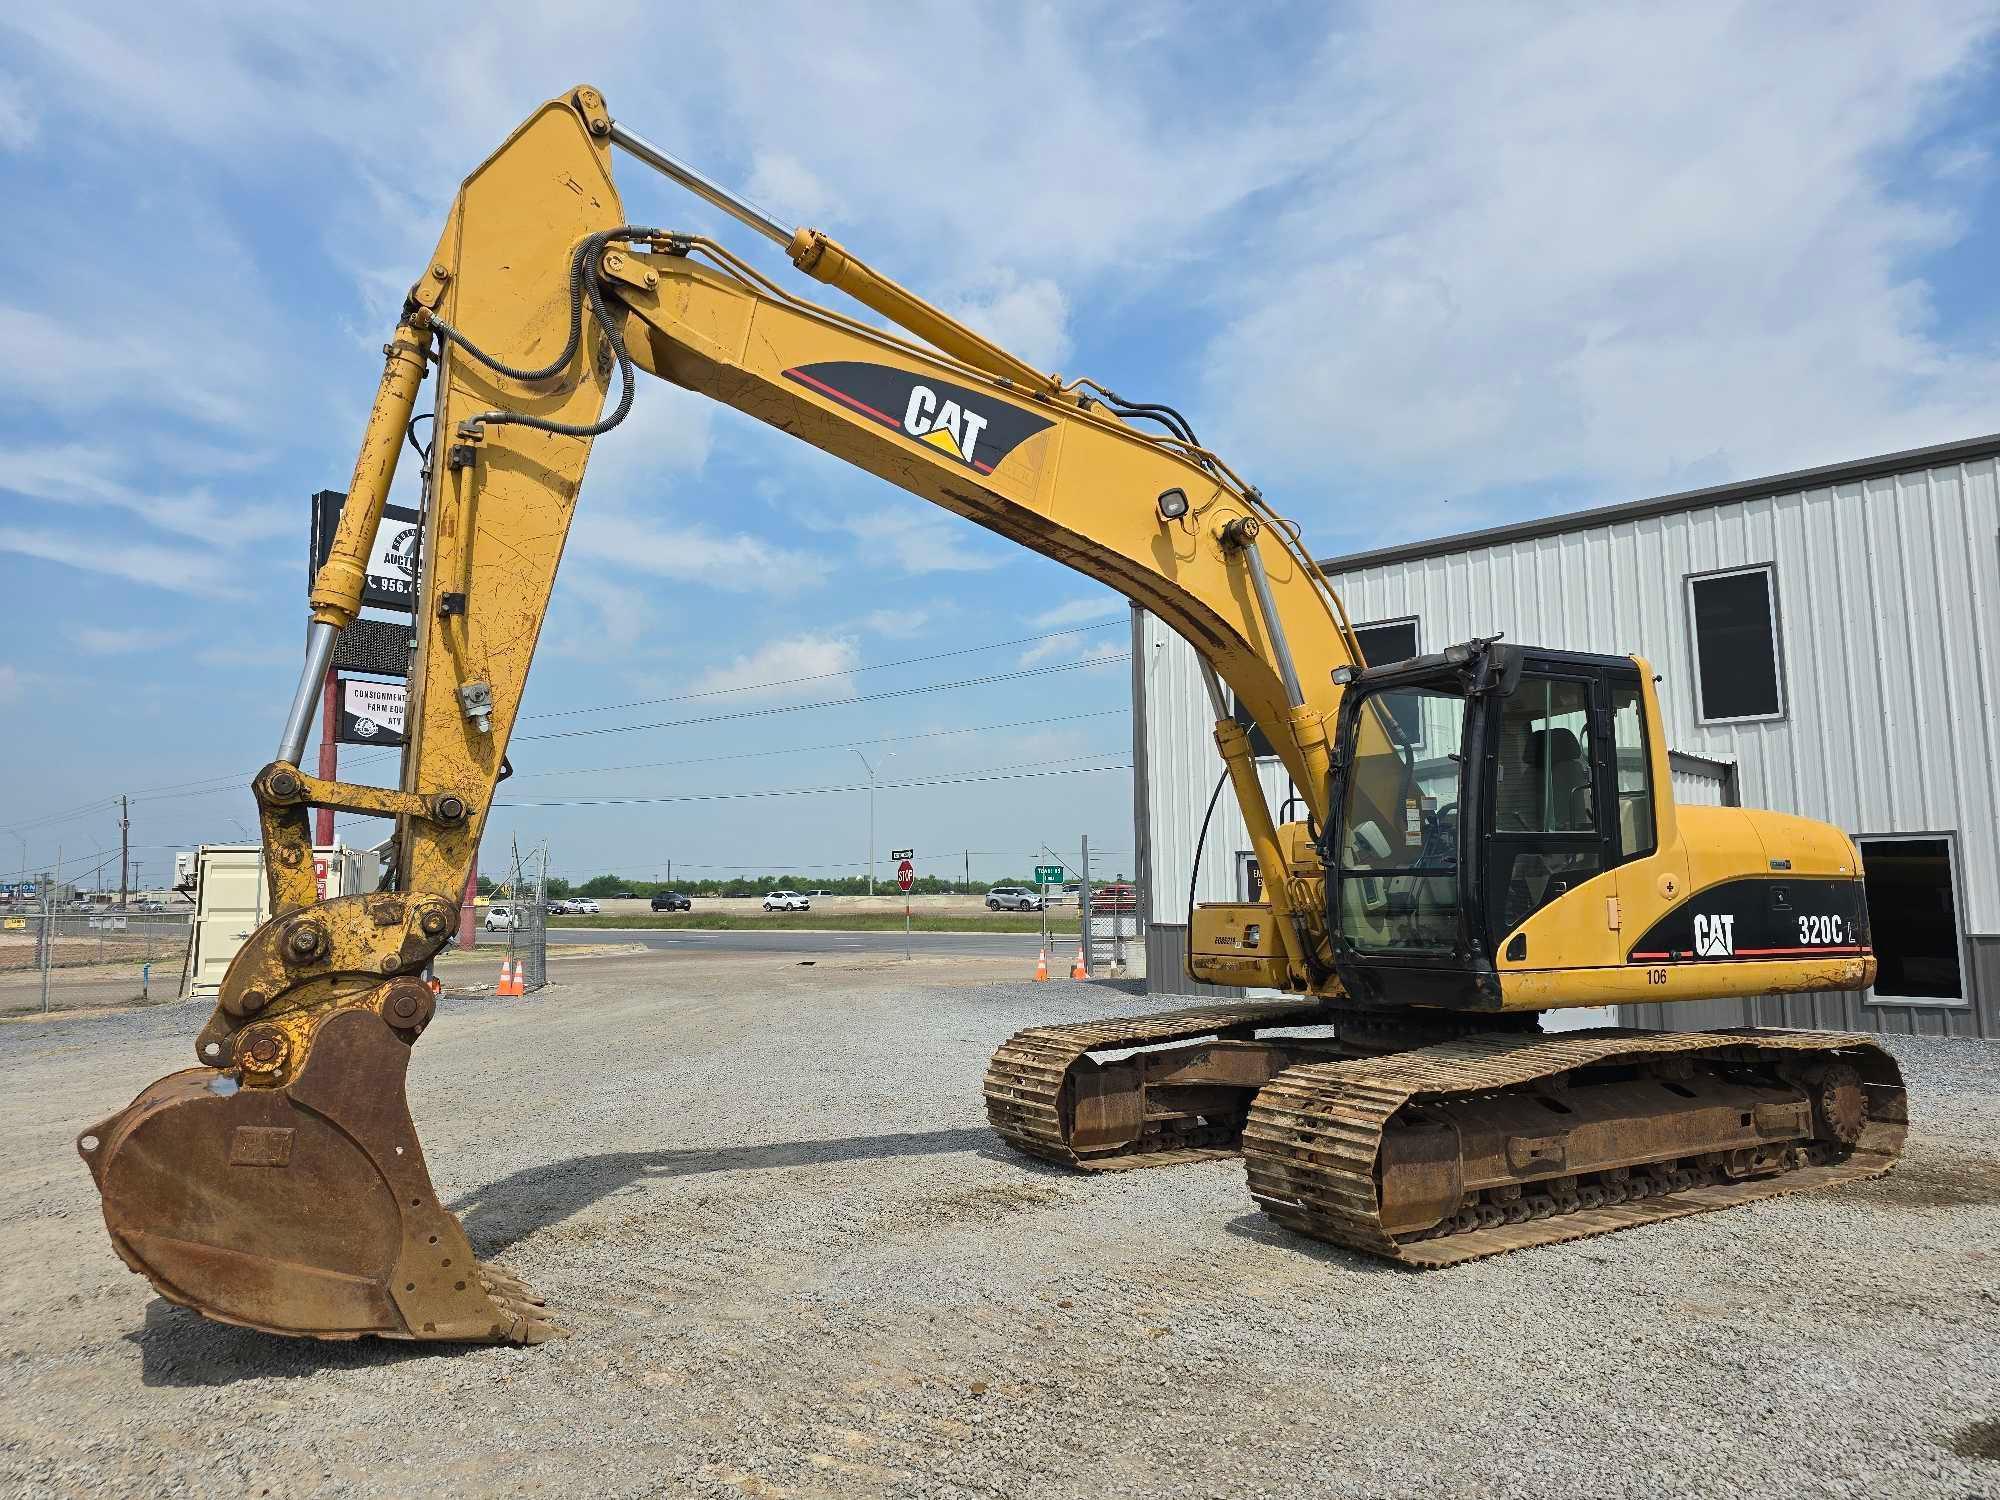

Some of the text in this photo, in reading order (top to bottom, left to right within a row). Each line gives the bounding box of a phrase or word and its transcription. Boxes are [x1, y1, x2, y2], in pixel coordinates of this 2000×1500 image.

[904, 385, 988, 463] CAT
[354, 689, 406, 702] CONSIGNMENT
[367, 703, 388, 713] FARM
[388, 716, 402, 726] ATV
[898, 869, 913, 882] STOP
[1693, 913, 1735, 957] CAT
[1798, 914, 1843, 945] 320C
[1646, 968, 1667, 985] 106
